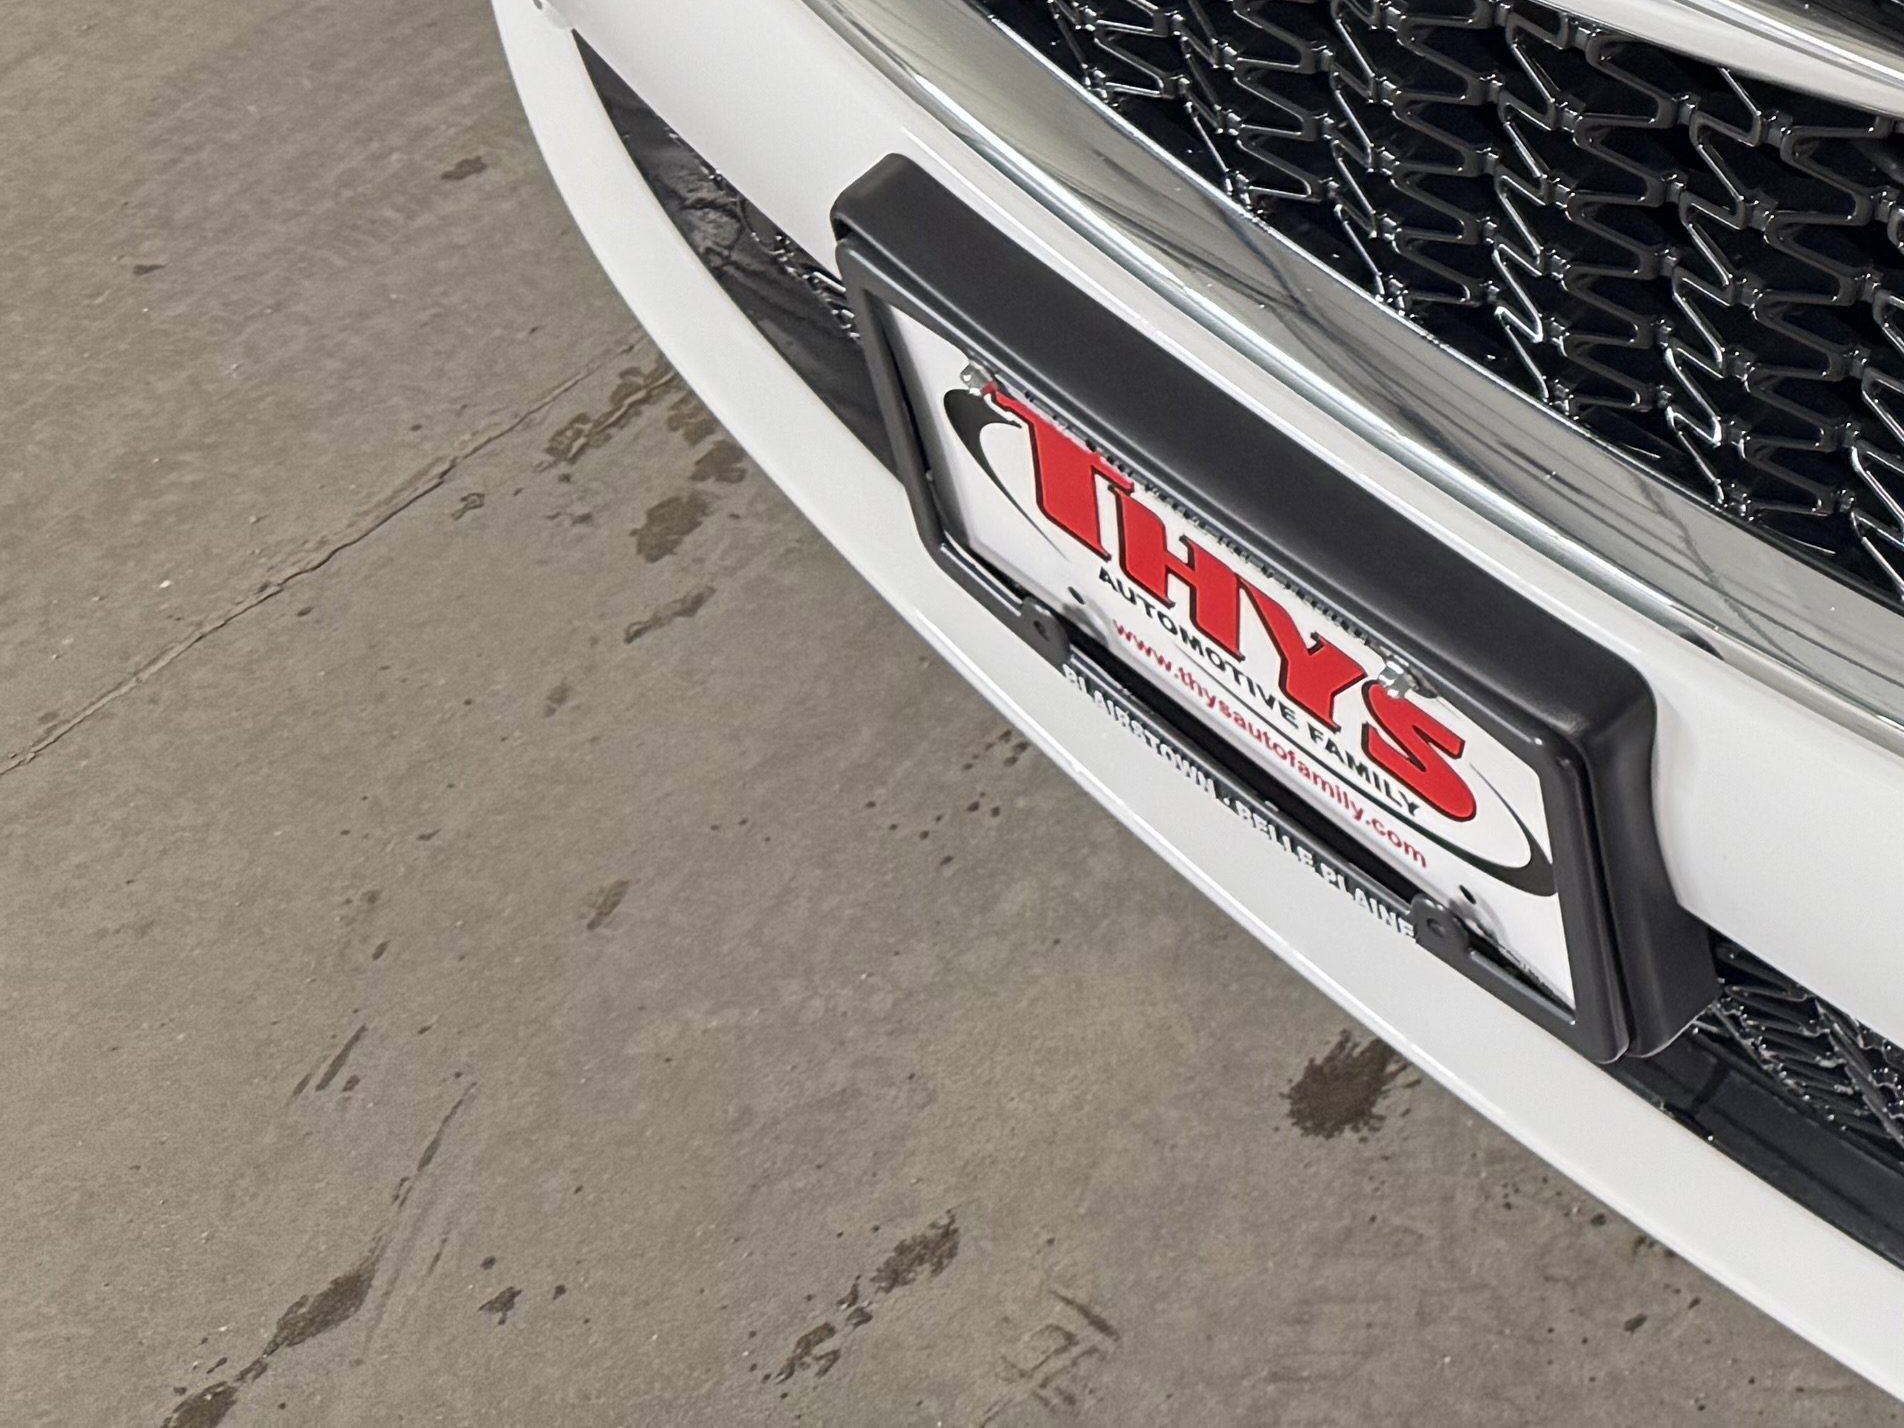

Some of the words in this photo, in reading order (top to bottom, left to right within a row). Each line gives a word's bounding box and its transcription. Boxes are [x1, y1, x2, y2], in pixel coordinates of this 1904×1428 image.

[984, 380, 1477, 824] THYS
[1099, 566, 1298, 730] AUTOMOTIVE
[1309, 722, 1421, 818] FAMILY
[1063, 663, 1219, 796] BLAIRSTOWN
[1237, 797, 1317, 869] BELLE
[1322, 866, 1416, 940] PLAINE
[1113, 619, 1429, 870] www.thysautofamily.com
